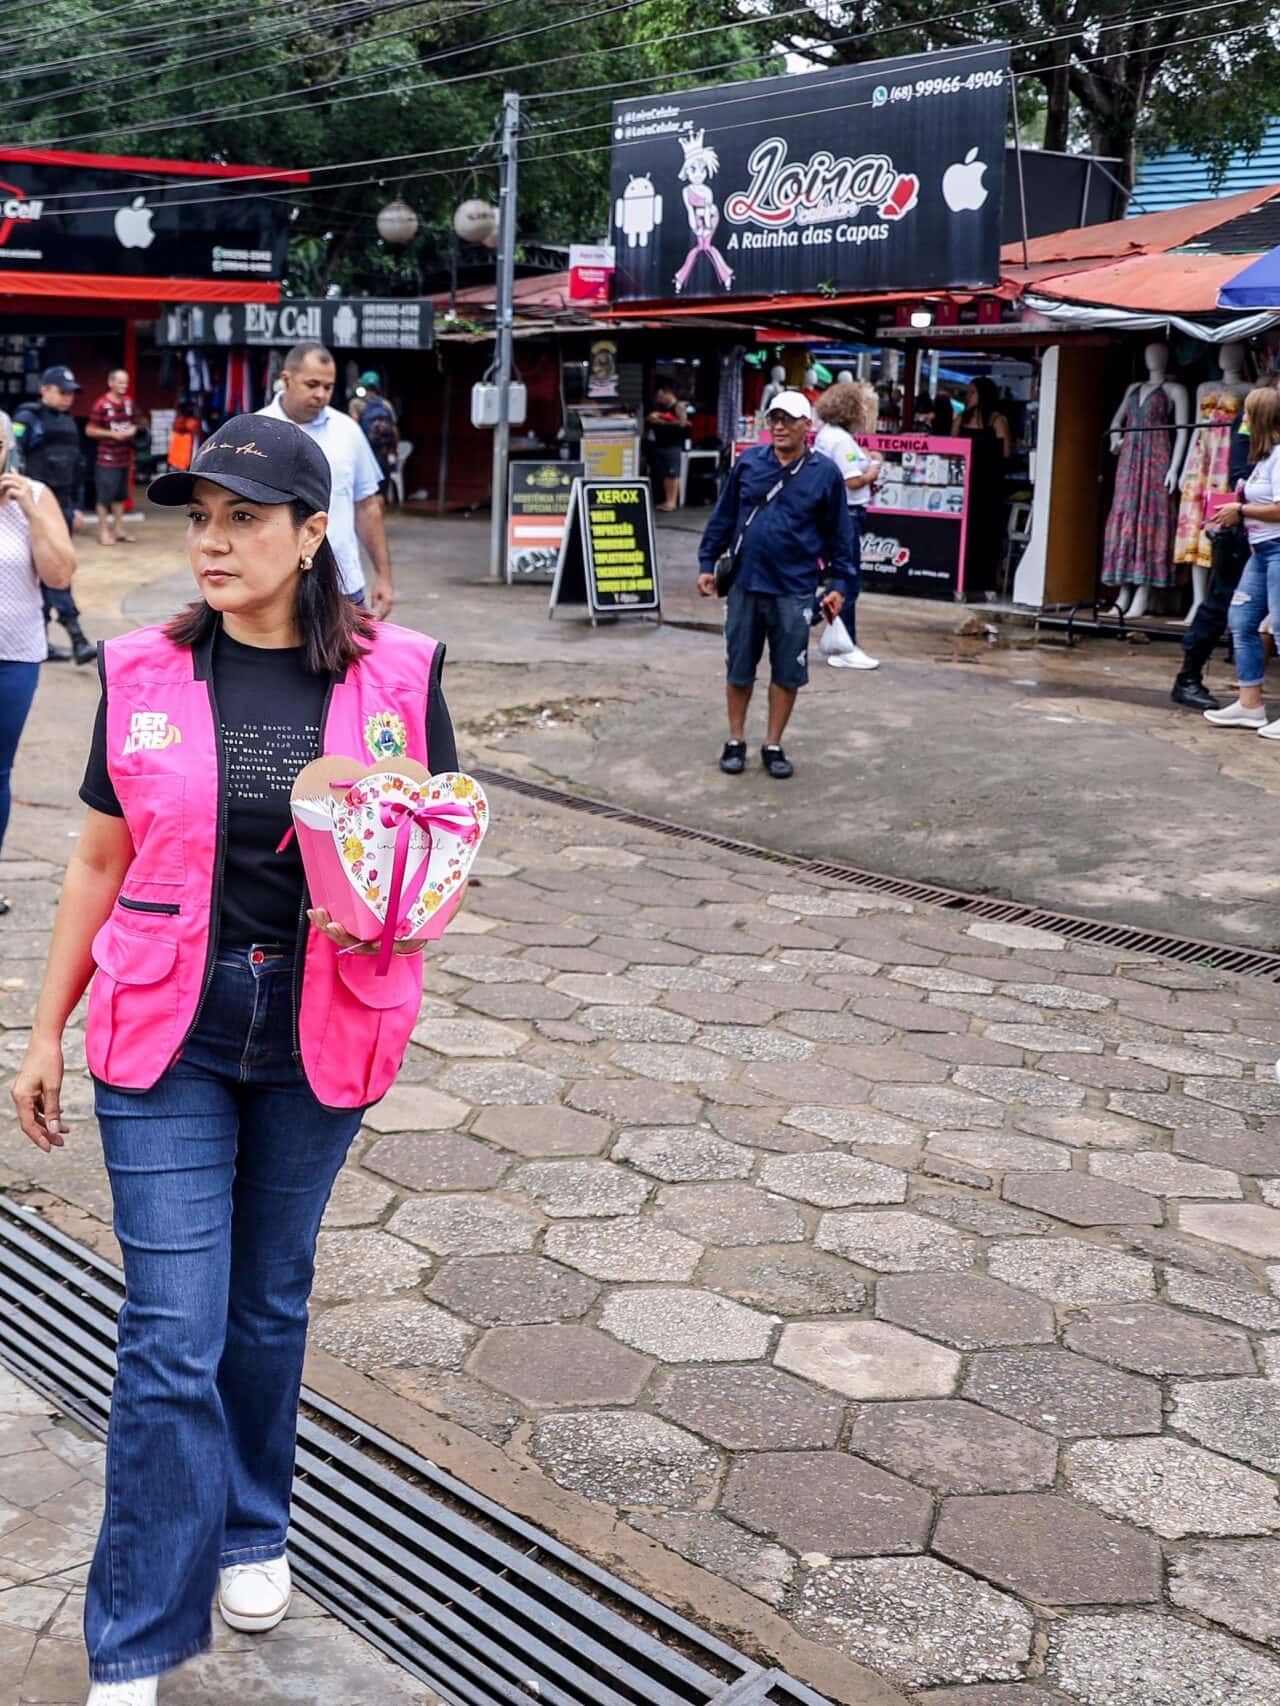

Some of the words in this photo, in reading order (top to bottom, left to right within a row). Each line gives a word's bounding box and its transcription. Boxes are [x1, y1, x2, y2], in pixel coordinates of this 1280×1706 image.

[890, 84, 913, 103] (68)
[915, 69, 1003, 97] 99966-4906
[726, 138, 896, 226] Loira
[3, 199, 43, 220] Cell
[727, 233, 739, 249] A
[742, 228, 798, 249] Rainha
[802, 225, 832, 245] das
[836, 223, 889, 245] Capas
[245, 303, 277, 338] Ely
[280, 305, 321, 337] Cell
[878, 439, 929, 450] TECNICA
[596, 489, 639, 504] XEROX
[130, 711, 168, 733] DER
[121, 730, 167, 756] ACRE
